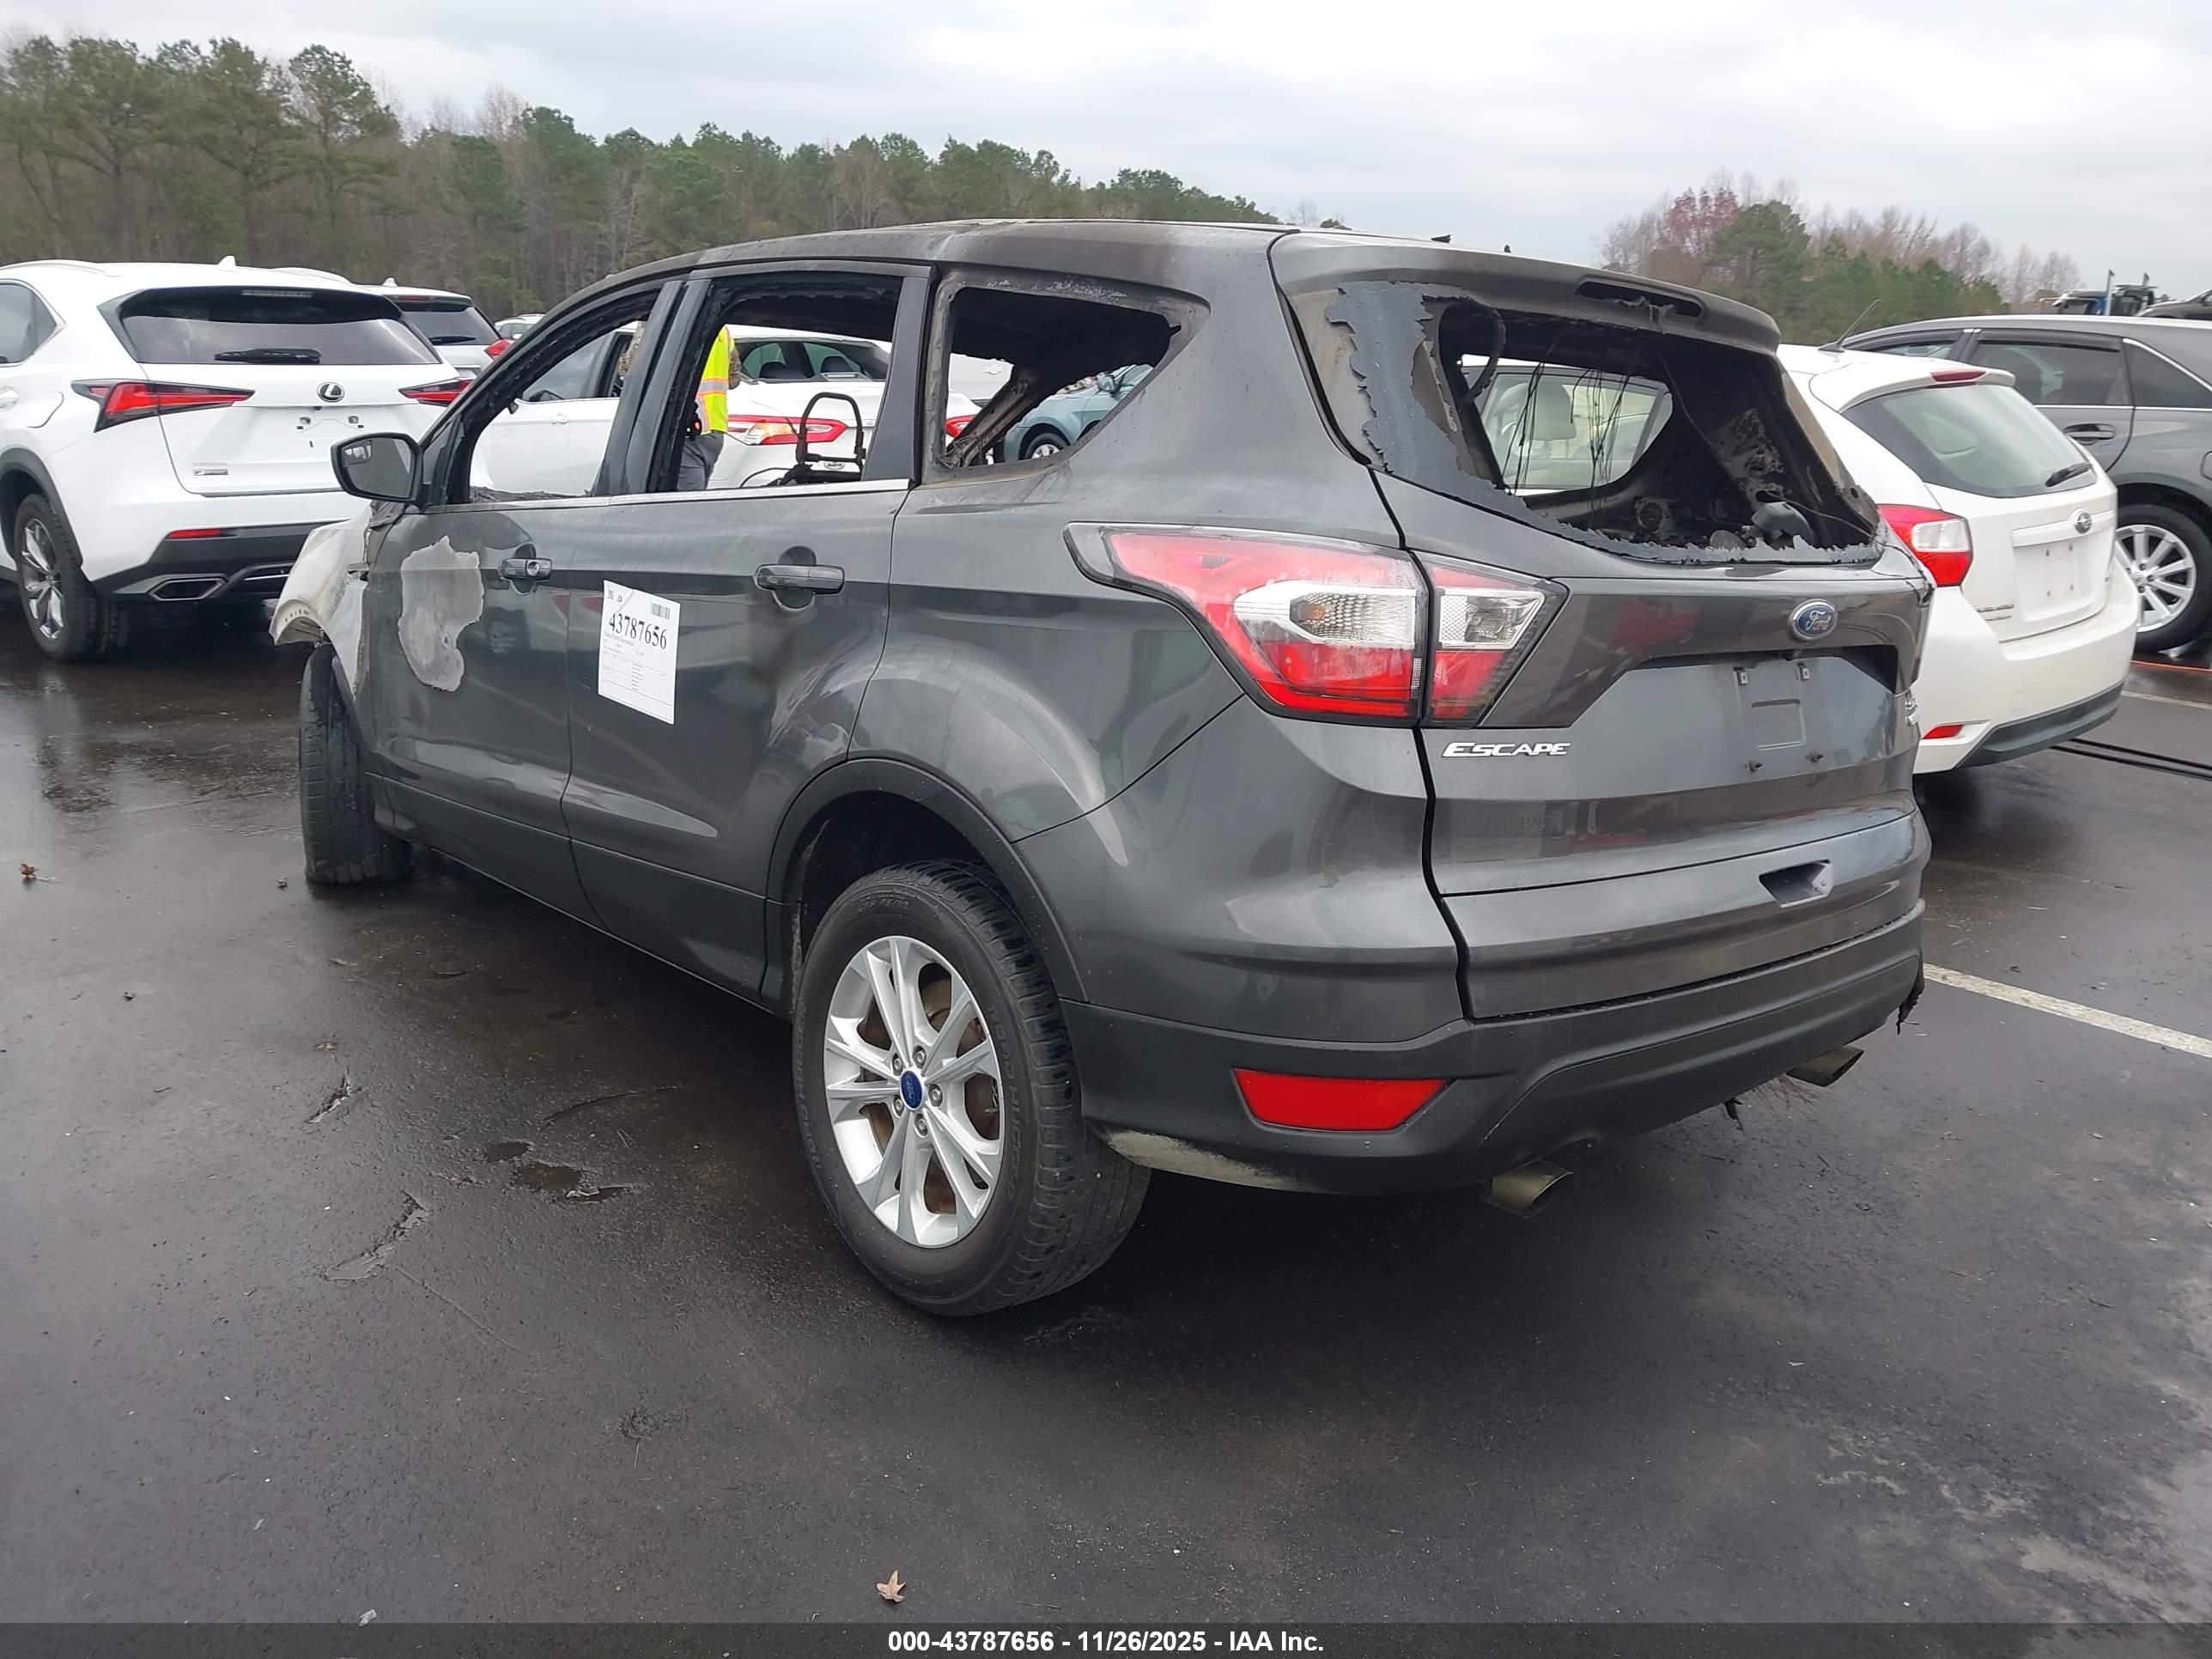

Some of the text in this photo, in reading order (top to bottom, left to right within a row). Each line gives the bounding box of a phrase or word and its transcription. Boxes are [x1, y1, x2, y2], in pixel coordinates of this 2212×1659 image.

[609, 612, 667, 650] 43787656
[1805, 610, 1832, 631] Ford
[1442, 742, 1571, 757] ESCAPE
